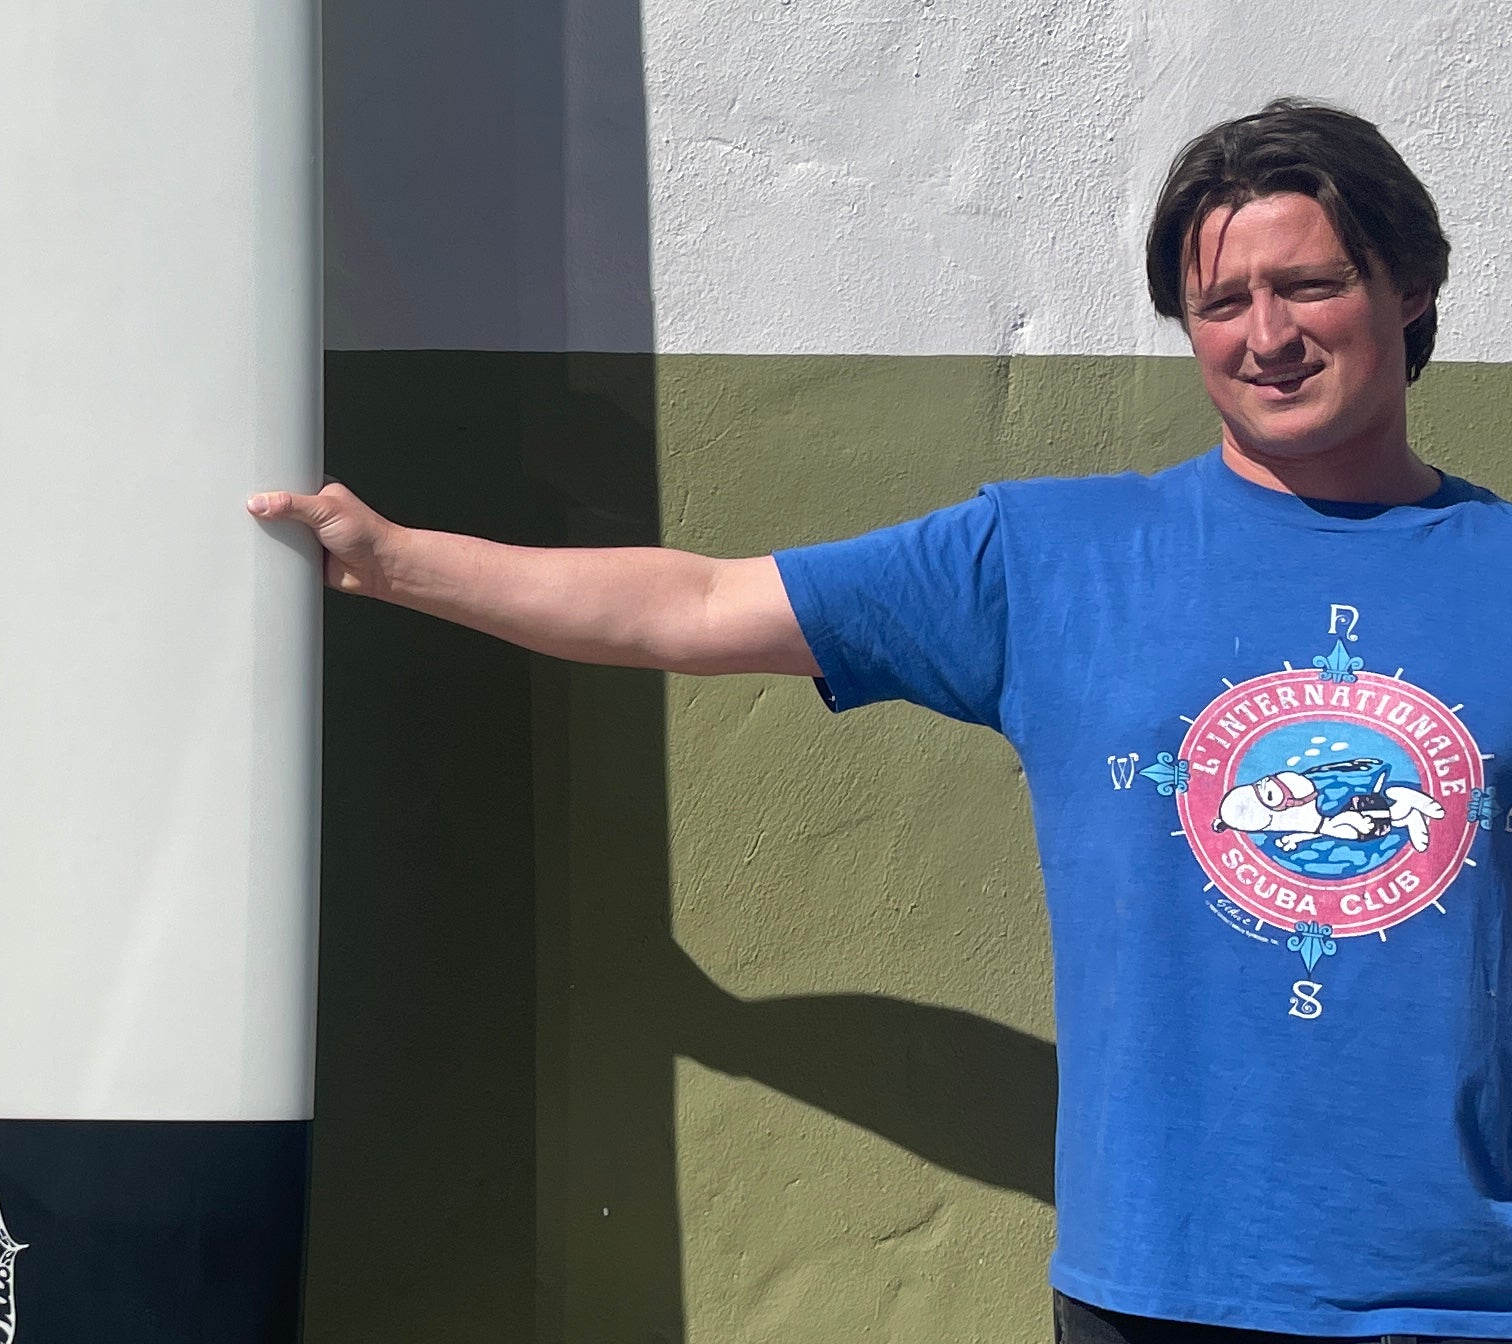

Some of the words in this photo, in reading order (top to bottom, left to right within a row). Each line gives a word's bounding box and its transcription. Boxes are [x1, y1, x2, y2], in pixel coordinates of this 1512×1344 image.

[1107, 752, 1139, 791] W
[1221, 847, 1318, 916] SCUBA
[1339, 870, 1421, 916] CLUB
[1288, 979, 1324, 1020] S
